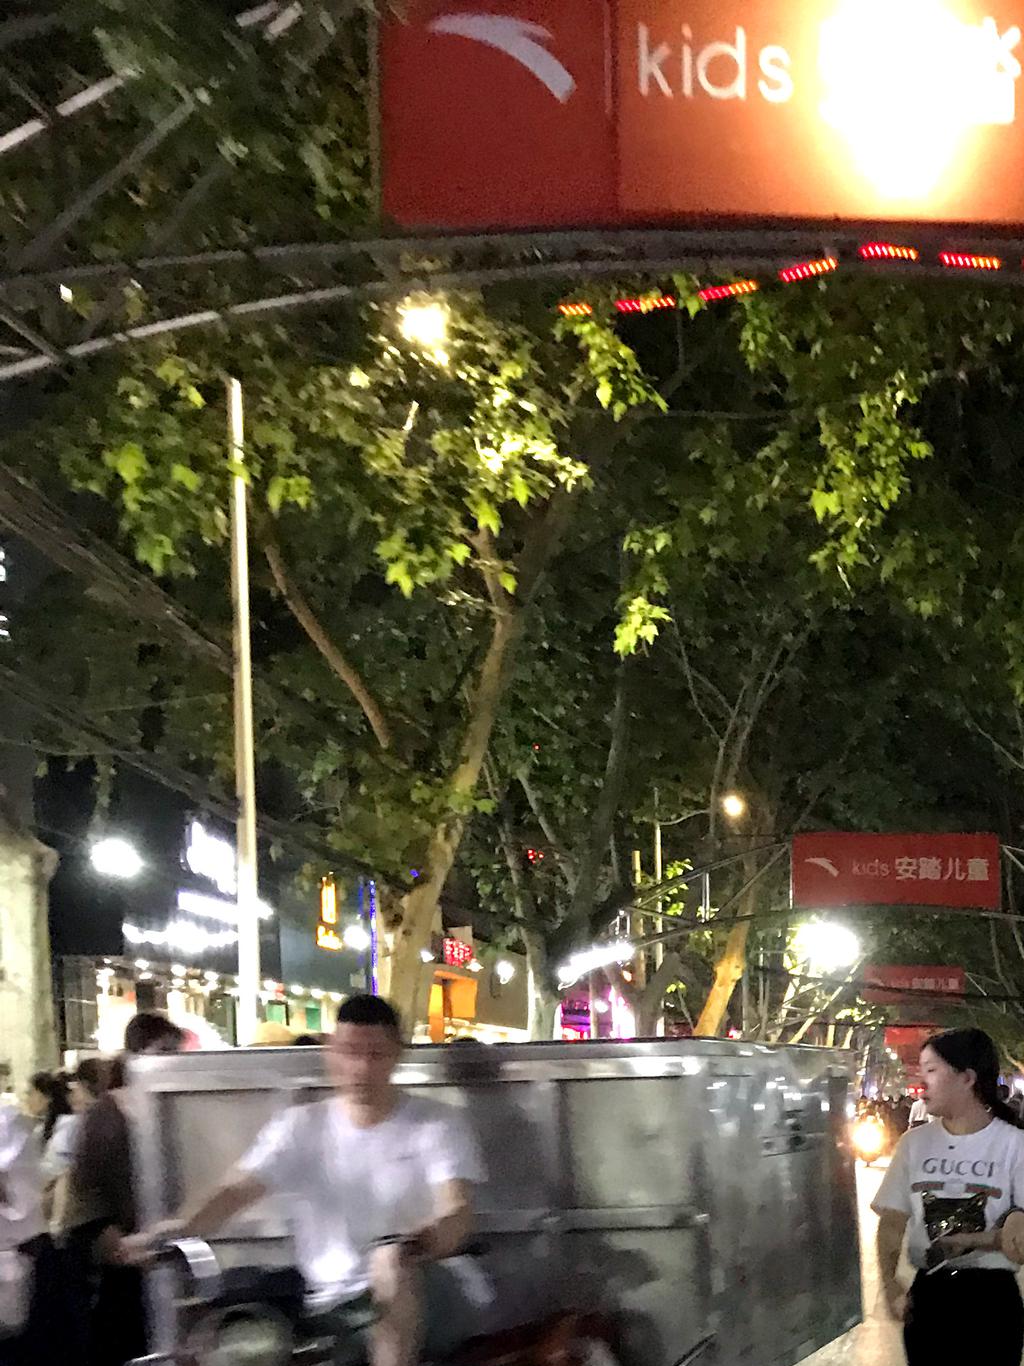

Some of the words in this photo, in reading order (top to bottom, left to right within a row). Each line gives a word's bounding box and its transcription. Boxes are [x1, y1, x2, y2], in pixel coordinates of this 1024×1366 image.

[636, 20, 795, 103] kids
[851, 858, 892, 877] kids
[921, 1156, 1000, 1179] GUCCI
